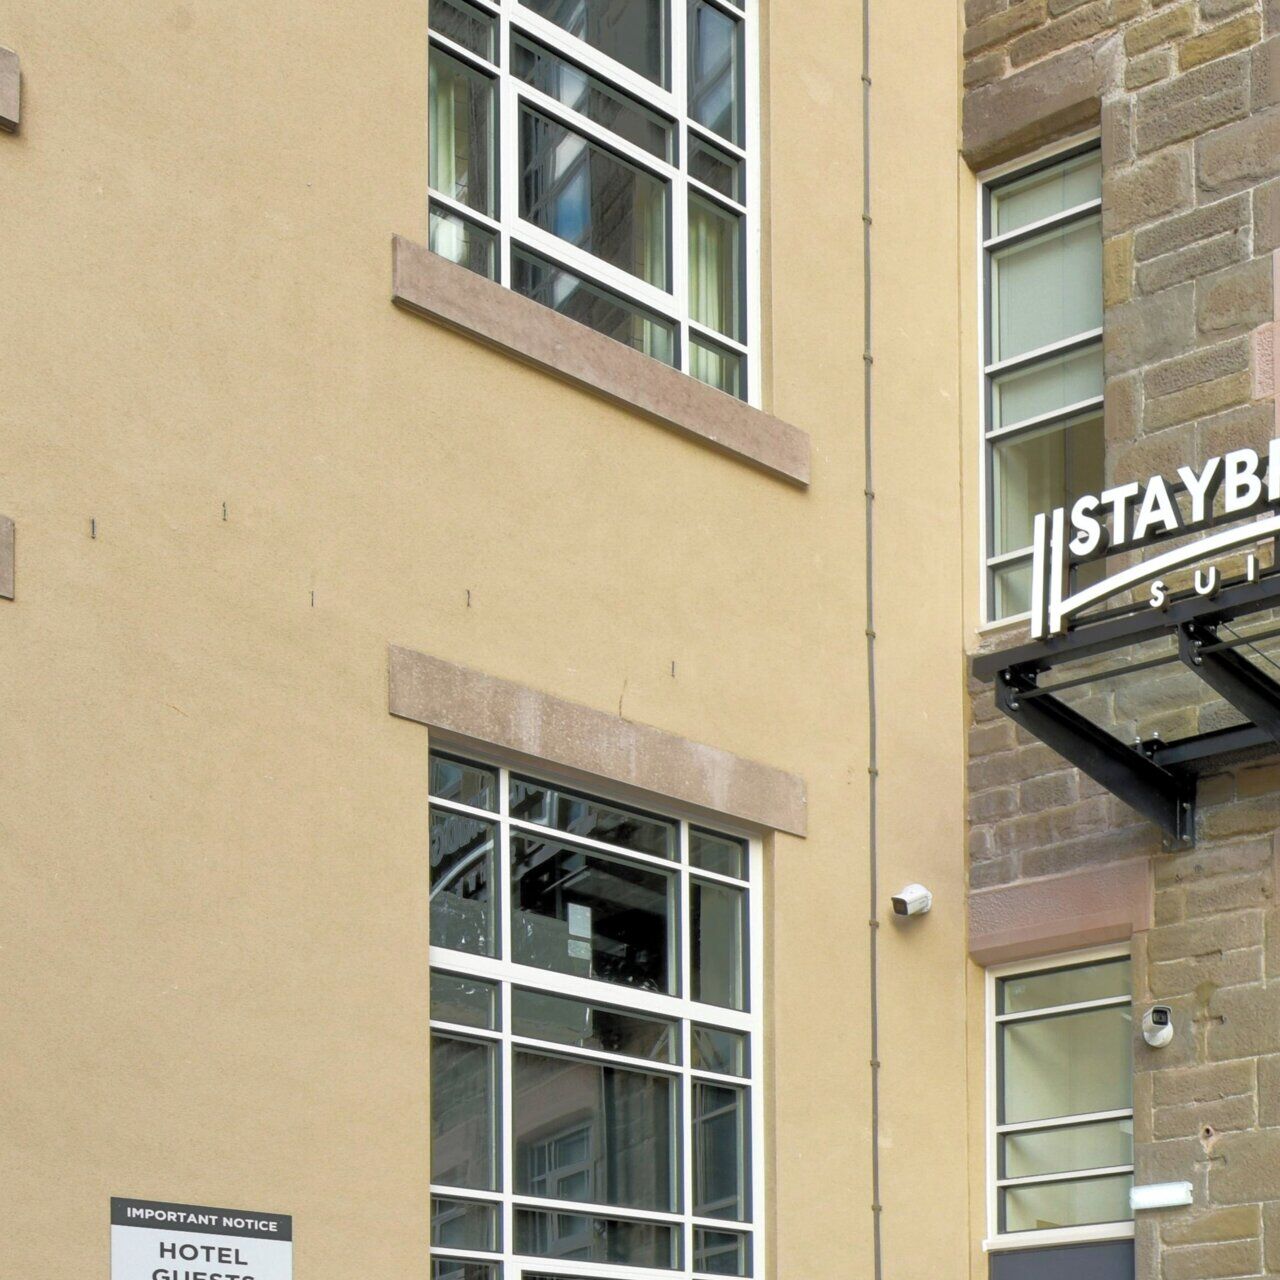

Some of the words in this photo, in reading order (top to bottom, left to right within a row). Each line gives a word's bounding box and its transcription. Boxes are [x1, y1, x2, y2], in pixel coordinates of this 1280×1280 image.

[127, 1207, 218, 1226] IMPORTANT
[222, 1217, 278, 1232] NOTICE
[159, 1242, 248, 1265] HOTEL
